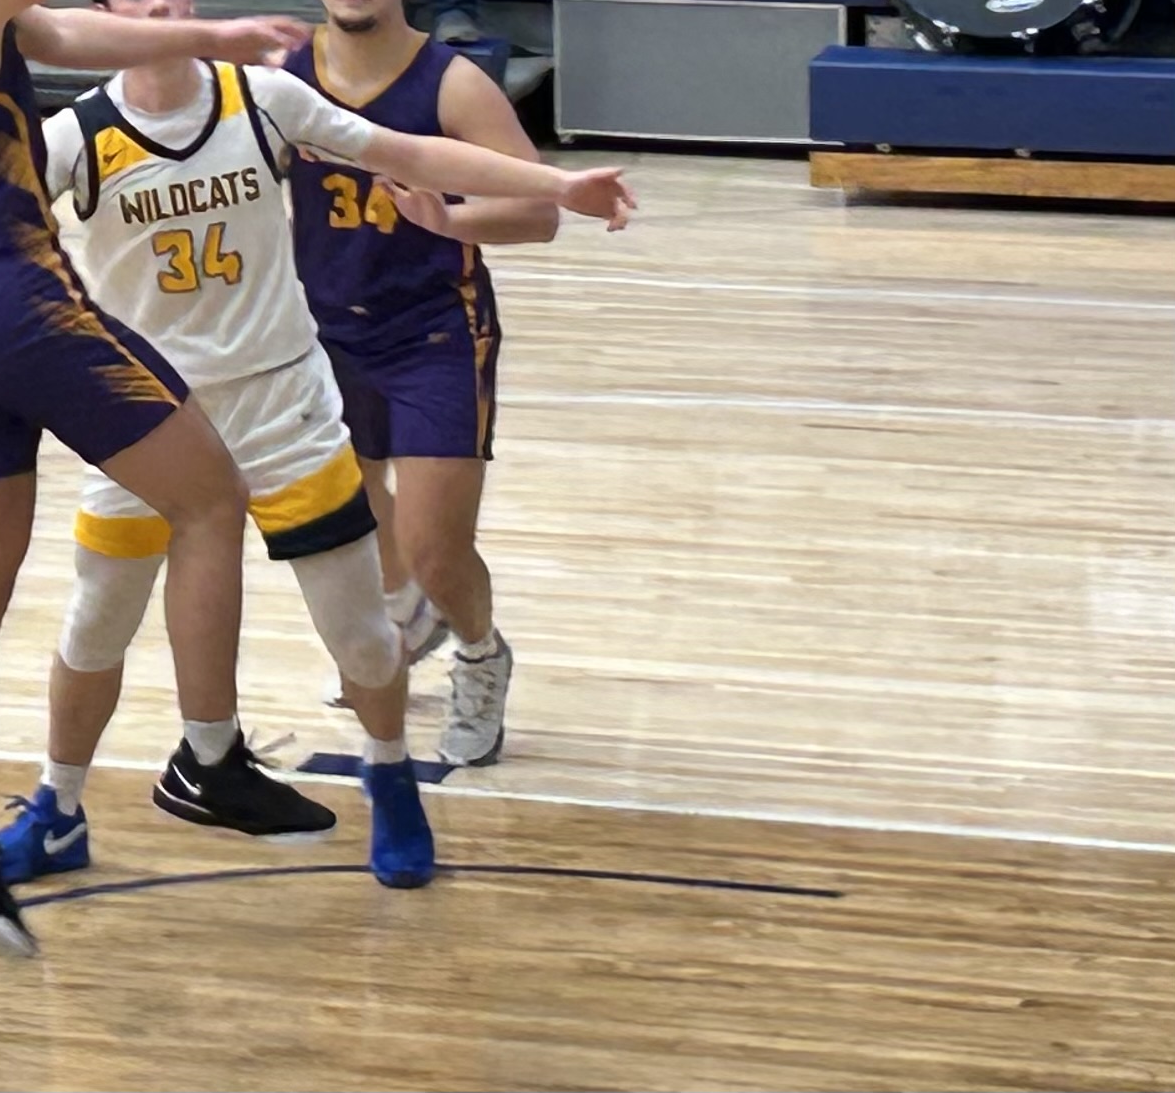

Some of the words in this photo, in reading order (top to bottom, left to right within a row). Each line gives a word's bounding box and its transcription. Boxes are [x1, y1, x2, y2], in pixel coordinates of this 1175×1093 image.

[119, 167, 260, 224] WILDCATS
[322, 173, 397, 234] 34
[152, 221, 243, 293] 34
